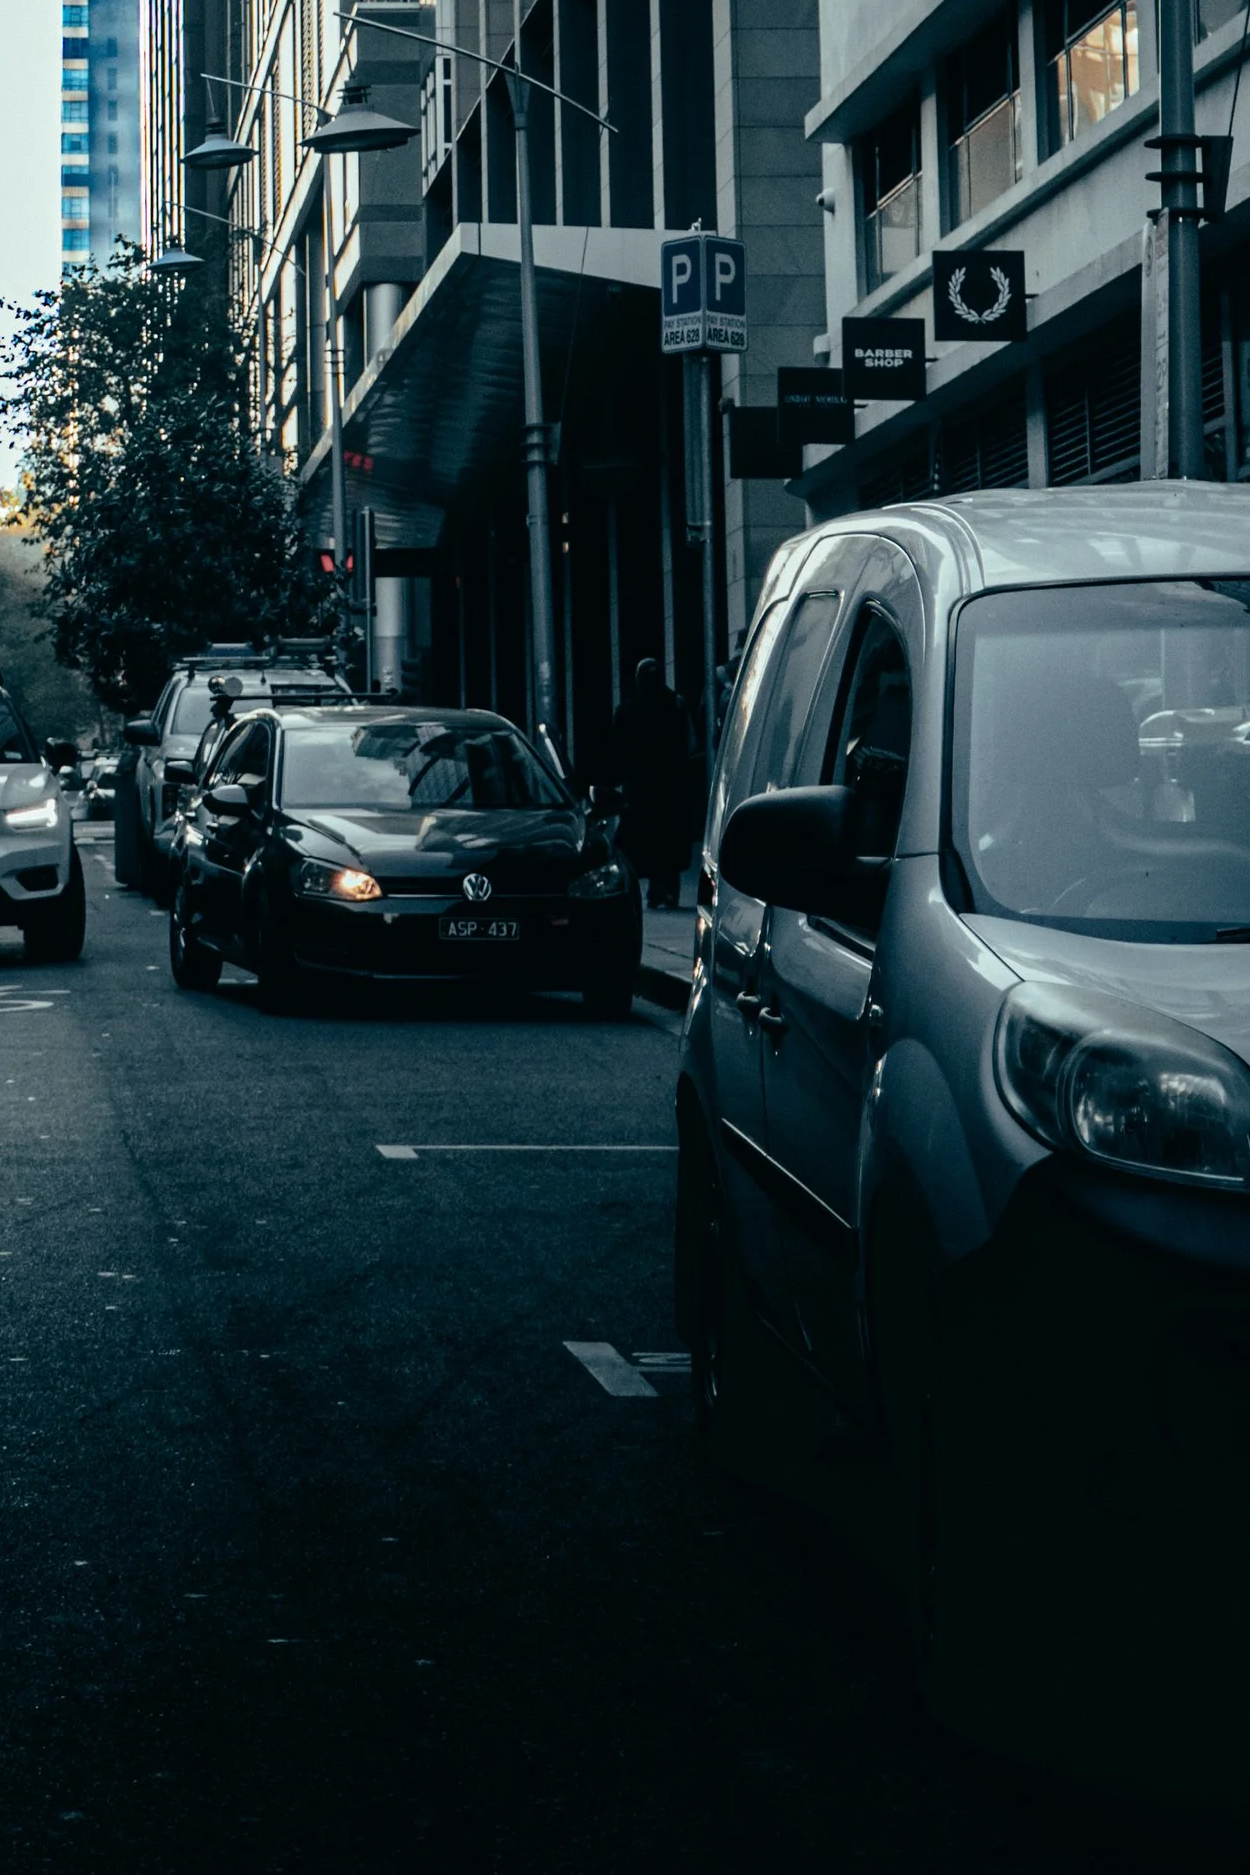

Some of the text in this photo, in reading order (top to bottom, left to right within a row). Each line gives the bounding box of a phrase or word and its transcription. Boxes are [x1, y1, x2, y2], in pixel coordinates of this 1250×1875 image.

[672, 253, 692, 304] P
[715, 252, 736, 301] P
[664, 328, 700, 346] AREA 628
[707, 327, 745, 346] AREA 628
[854, 348, 913, 358] BARBER
[864, 358, 904, 367] SHOP
[448, 921, 478, 936] ASP
[488, 922, 517, 937] 437
